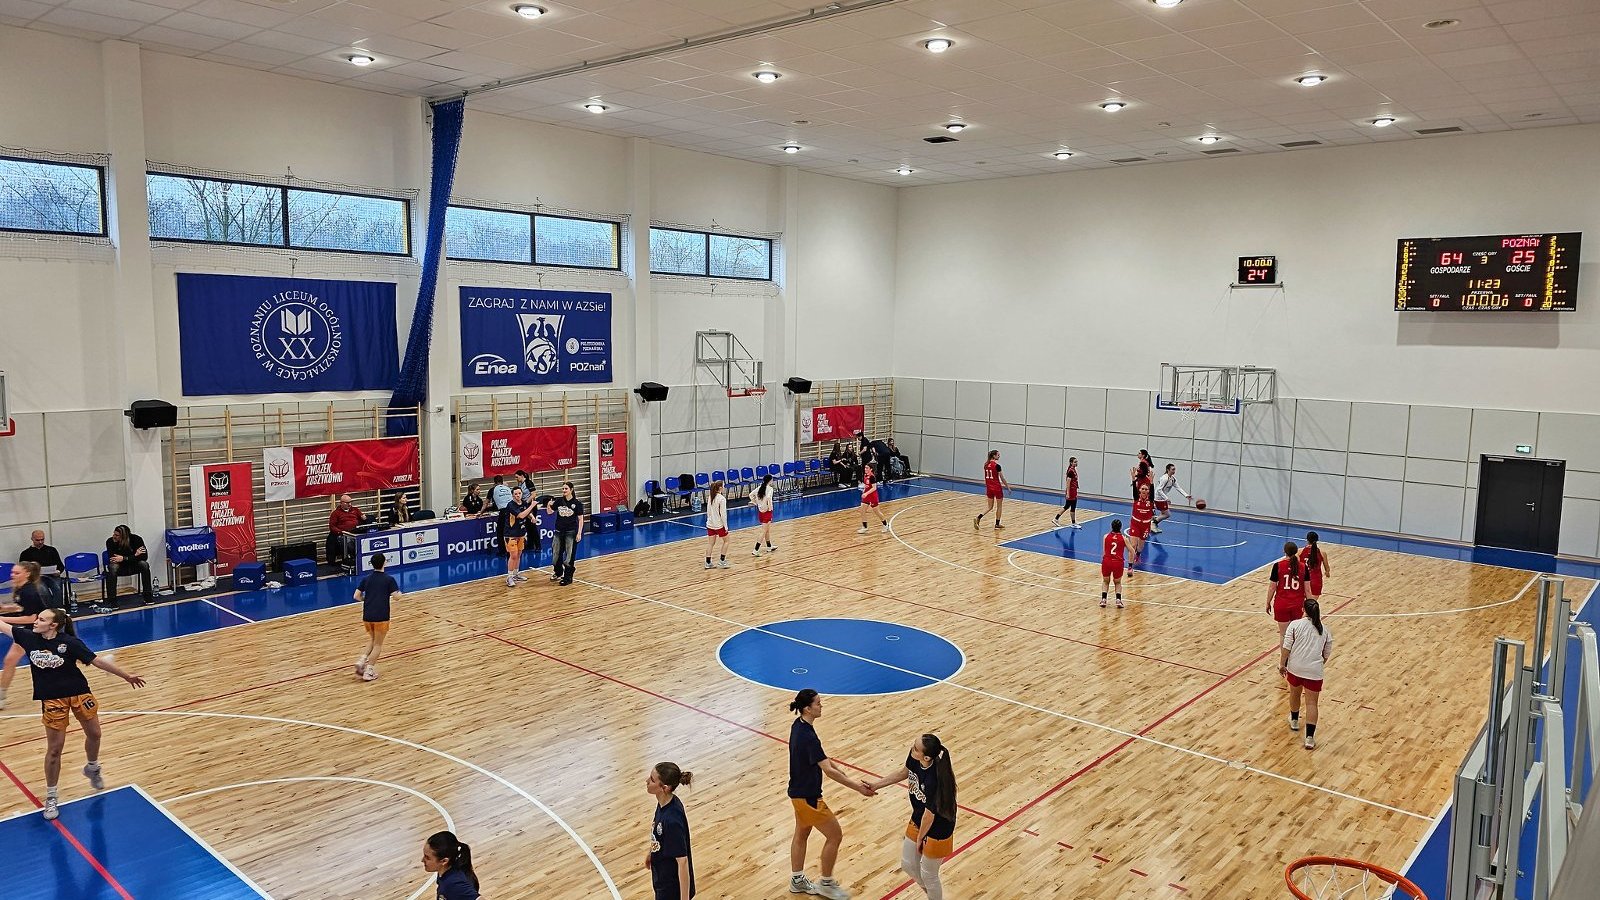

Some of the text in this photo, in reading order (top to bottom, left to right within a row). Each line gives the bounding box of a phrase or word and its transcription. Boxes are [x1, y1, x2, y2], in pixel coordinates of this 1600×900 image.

[1441, 252, 1463, 265] 64
[1480, 256, 1488, 264] 3
[1512, 250, 1535, 264] 25
[1430, 266, 1471, 274] GOSPODARZE
[1506, 264, 1531, 272] GOŚCIE
[1248, 270, 1265, 280] 24
[1469, 279, 1500, 289] 11:23
[468, 296, 606, 312] ZAGRAJ Z NAMI W AZSie!
[1433, 299, 1440, 307] 0
[1524, 298, 1533, 306] 0
[250, 290, 342, 381] LICEUM OGÓLNOKSZTAŁCĄCE W POZNANIU
[278, 337, 316, 360] XX
[474, 361, 518, 375] Enea
[304, 453, 327, 466] POLSKI
[305, 462, 333, 476] ZWIĄZEK
[985, 469, 994, 479] 11
[305, 471, 344, 486] KOSZYKÓWKI
[210, 500, 230, 511] POLSKI
[211, 508, 234, 519] ZWIĄZEK
[212, 515, 245, 528] KOSZYKÓWKI
[178, 543, 210, 553] molten
[1110, 542, 1118, 555] 2
[1283, 574, 1300, 590] 16
[82, 699, 96, 710] 16
